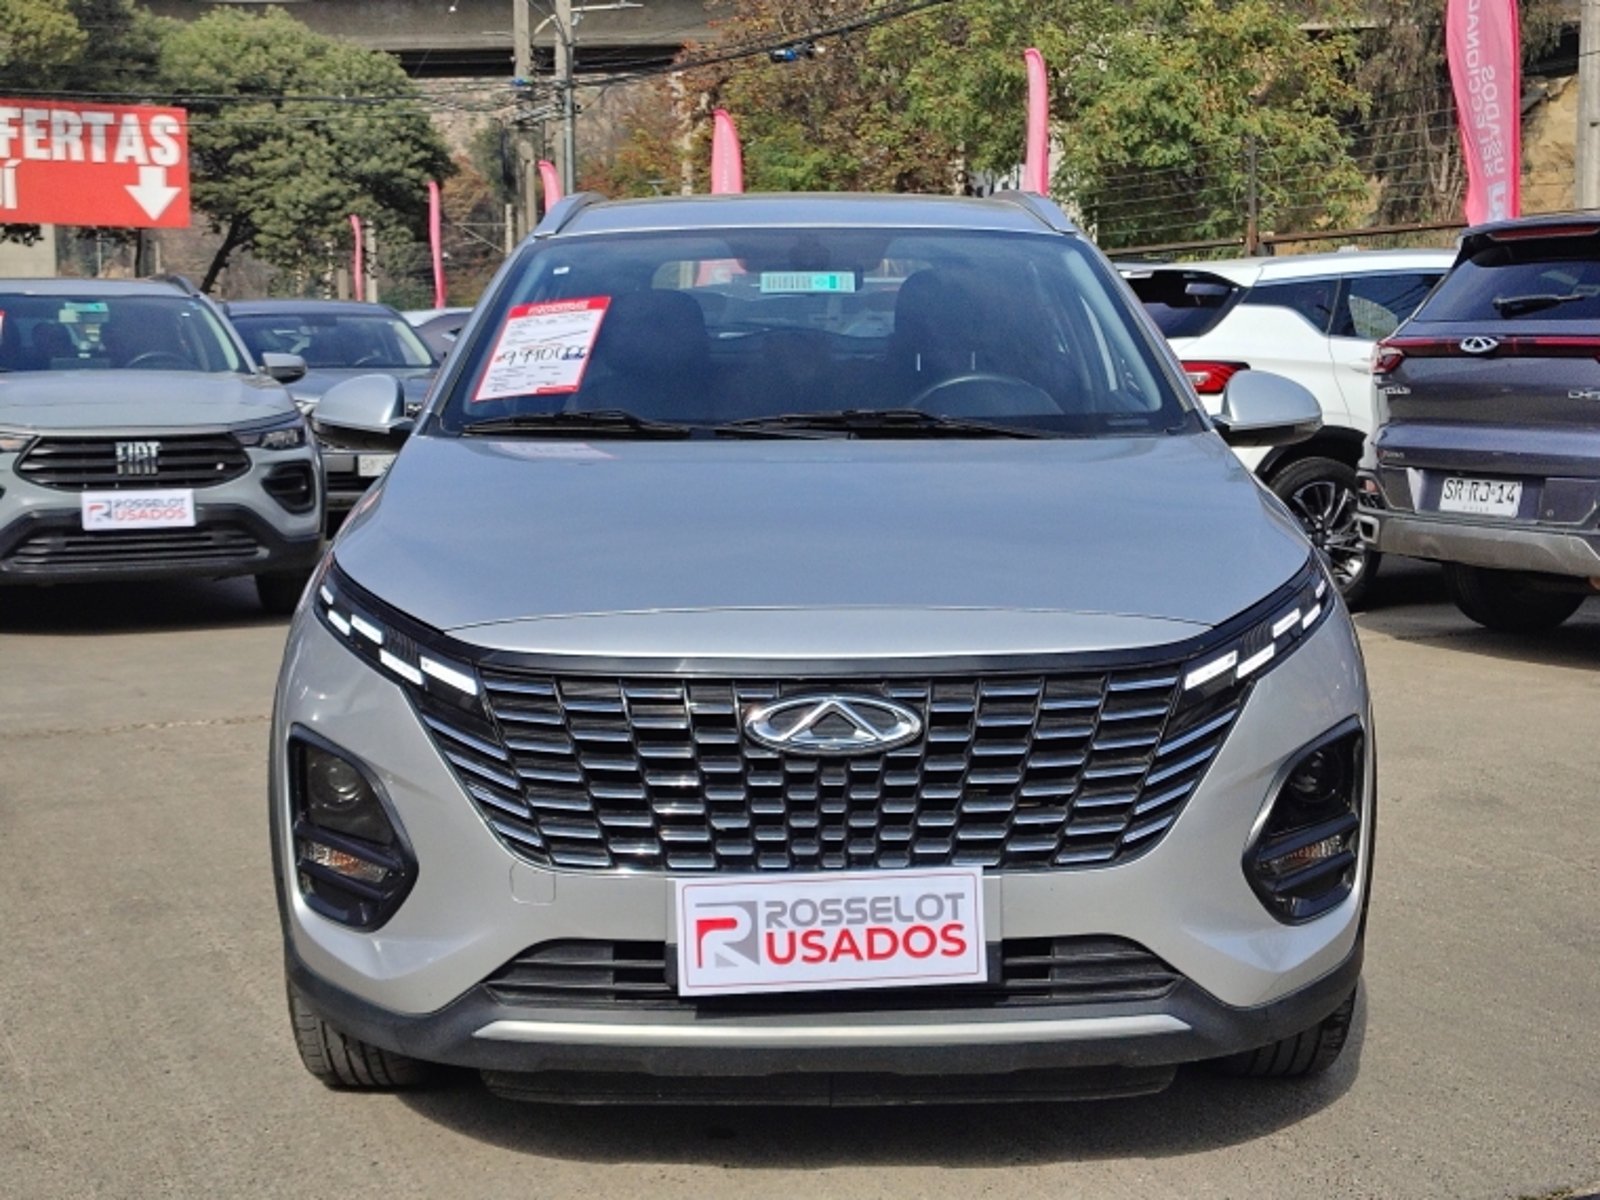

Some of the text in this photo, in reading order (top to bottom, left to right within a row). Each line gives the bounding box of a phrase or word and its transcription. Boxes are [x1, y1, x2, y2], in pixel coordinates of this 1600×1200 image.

[115, 440, 161, 475] FIAT
[114, 497, 185, 509] ROSSELOT
[115, 507, 187, 521] USADOS
[764, 892, 965, 929] ROSSELOT
[765, 923, 967, 966] USADOS
